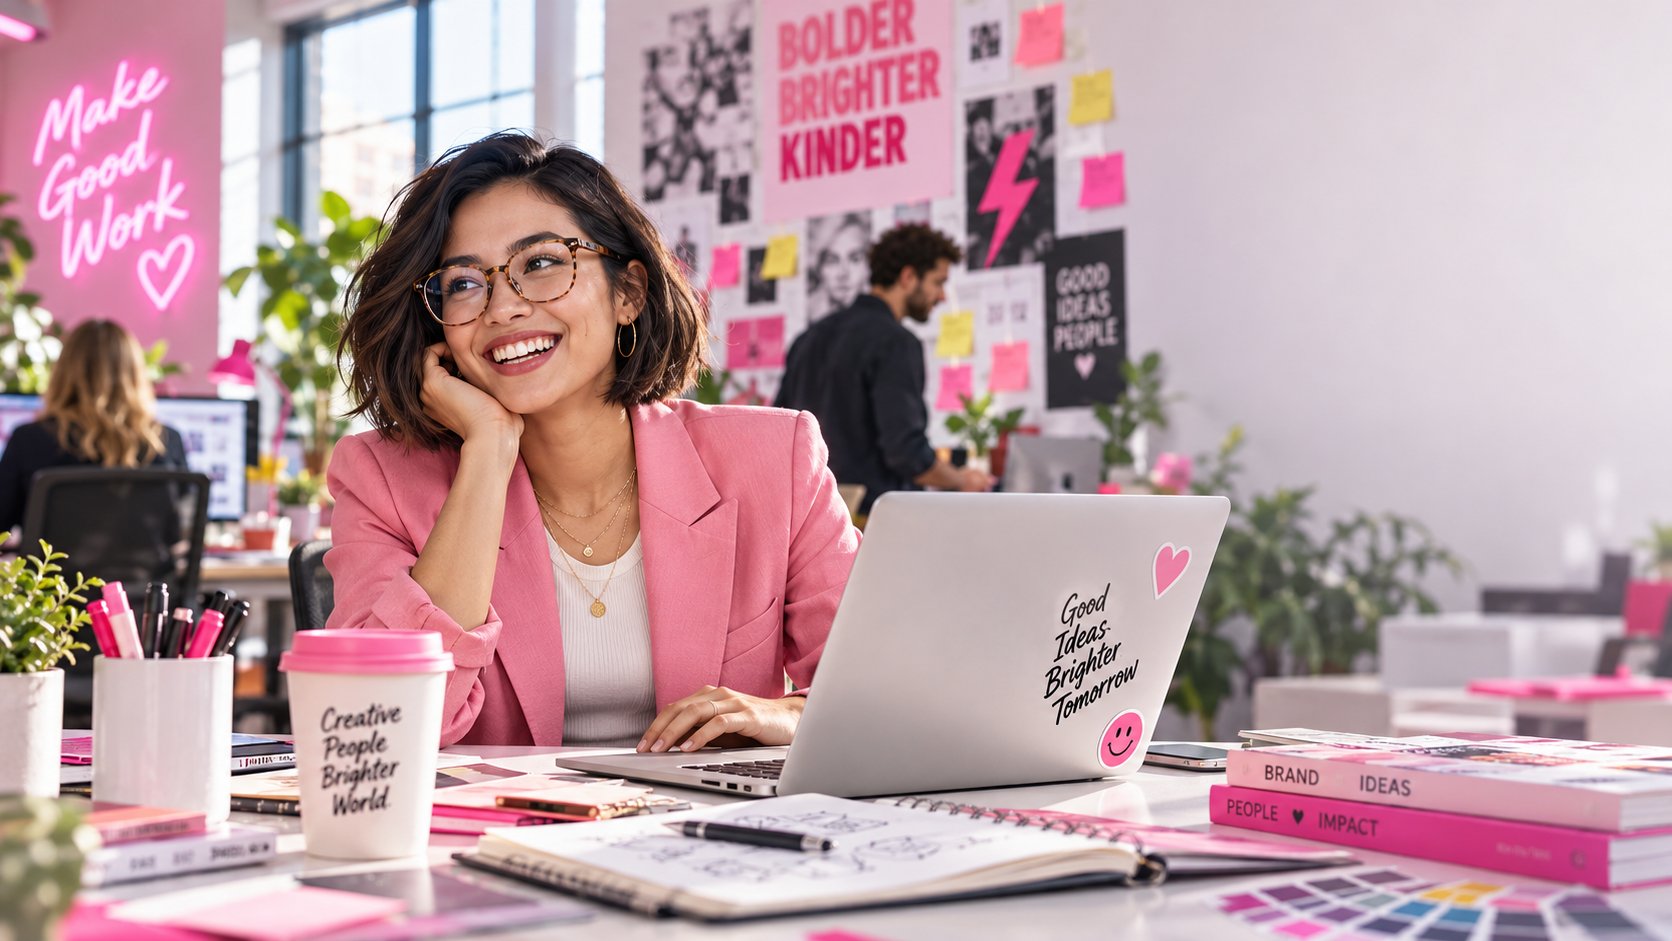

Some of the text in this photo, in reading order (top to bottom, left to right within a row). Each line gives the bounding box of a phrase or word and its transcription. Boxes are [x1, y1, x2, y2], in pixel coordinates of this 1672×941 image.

[778, 0, 915, 71] BOLDER
[779, 49, 941, 127] BRIGHTER
[33, 60, 169, 166] Make
[38, 108, 154, 221] Good
[780, 114, 907, 183] KINDER
[61, 158, 189, 279] Work
[1055, 261, 1111, 295] GOOD
[1056, 290, 1112, 324] IDEAS
[1053, 317, 1119, 352] PEOPLE
[1060, 582, 1111, 627] Good
[1043, 642, 1122, 699] Brighter
[1051, 659, 1139, 725] Tomorrow
[320, 703, 402, 734] Creative
[322, 730, 389, 764] People
[321, 760, 400, 792] Brighter
[1264, 764, 1412, 797] BRAND IDEAS
[1227, 799, 1379, 838] PEOPLE IMPACT
